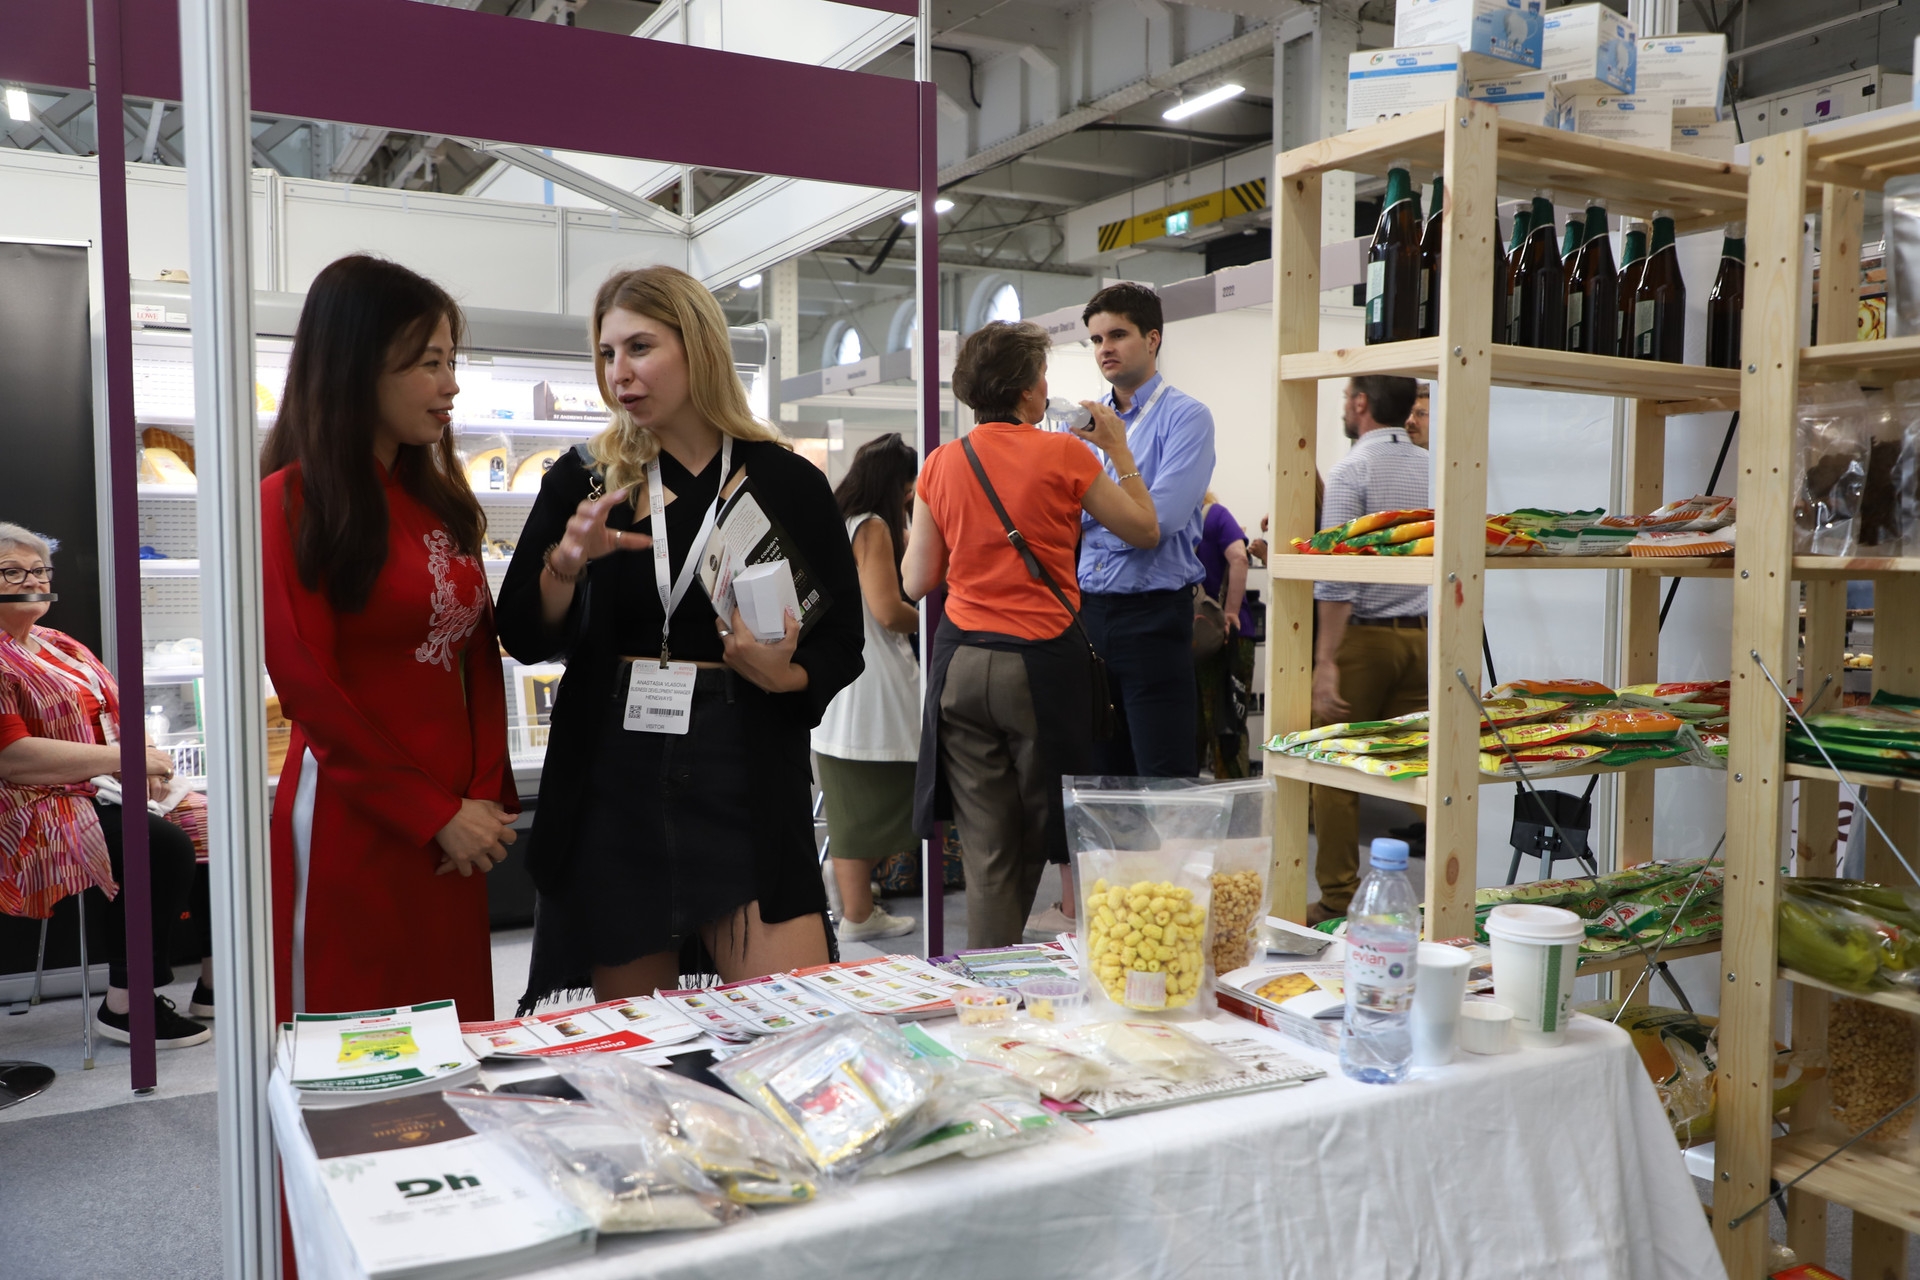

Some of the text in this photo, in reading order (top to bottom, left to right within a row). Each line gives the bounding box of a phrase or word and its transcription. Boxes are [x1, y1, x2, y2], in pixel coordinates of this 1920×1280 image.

[136, 312, 158, 321] LOWE
[1352, 950, 1387, 966] evian
[395, 1173, 483, 1199] Dh
